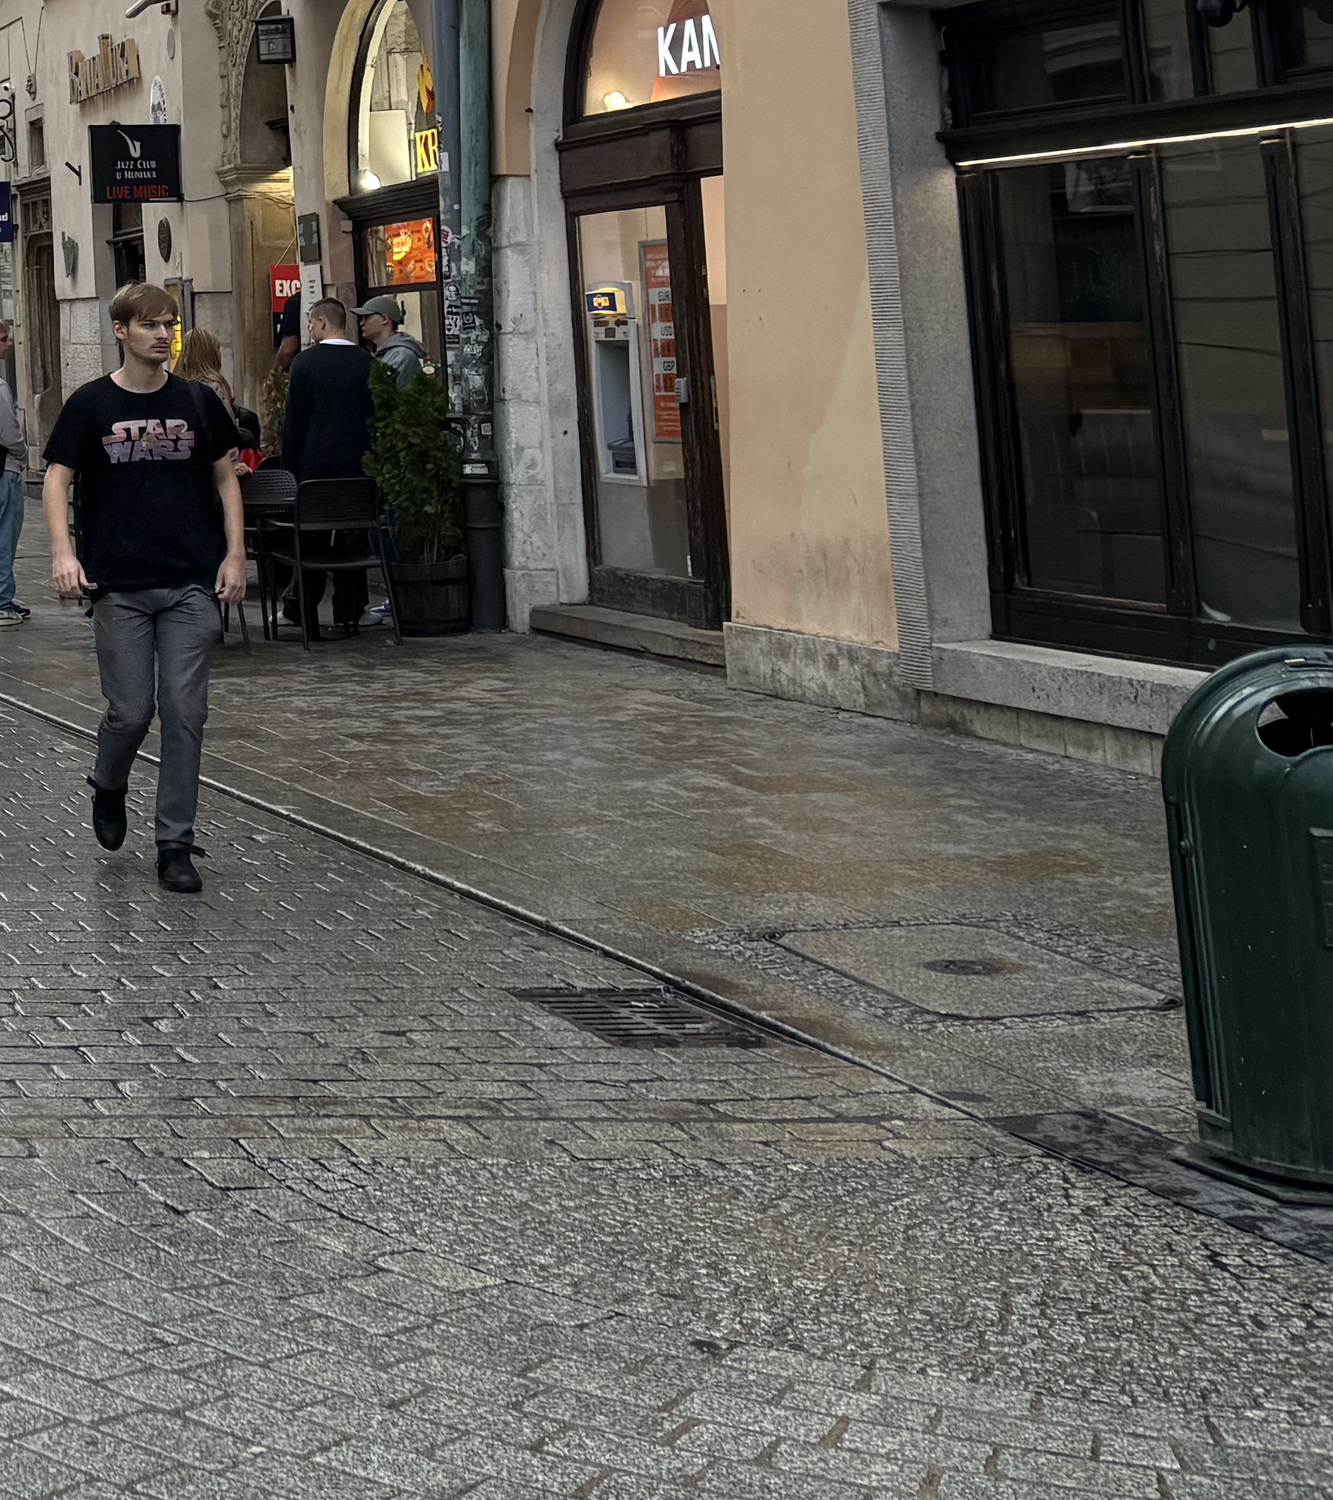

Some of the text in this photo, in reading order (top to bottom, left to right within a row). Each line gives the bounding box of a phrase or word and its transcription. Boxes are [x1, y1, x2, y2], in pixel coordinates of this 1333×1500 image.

[415, 128, 438, 173] KR
[115, 159, 157, 169] JAZZ CLUB
[106, 184, 169, 199] LIVE MUSIC
[660, 326, 673, 337] USD
[102, 419, 195, 445] STAR
[103, 440, 195, 463] WARS
